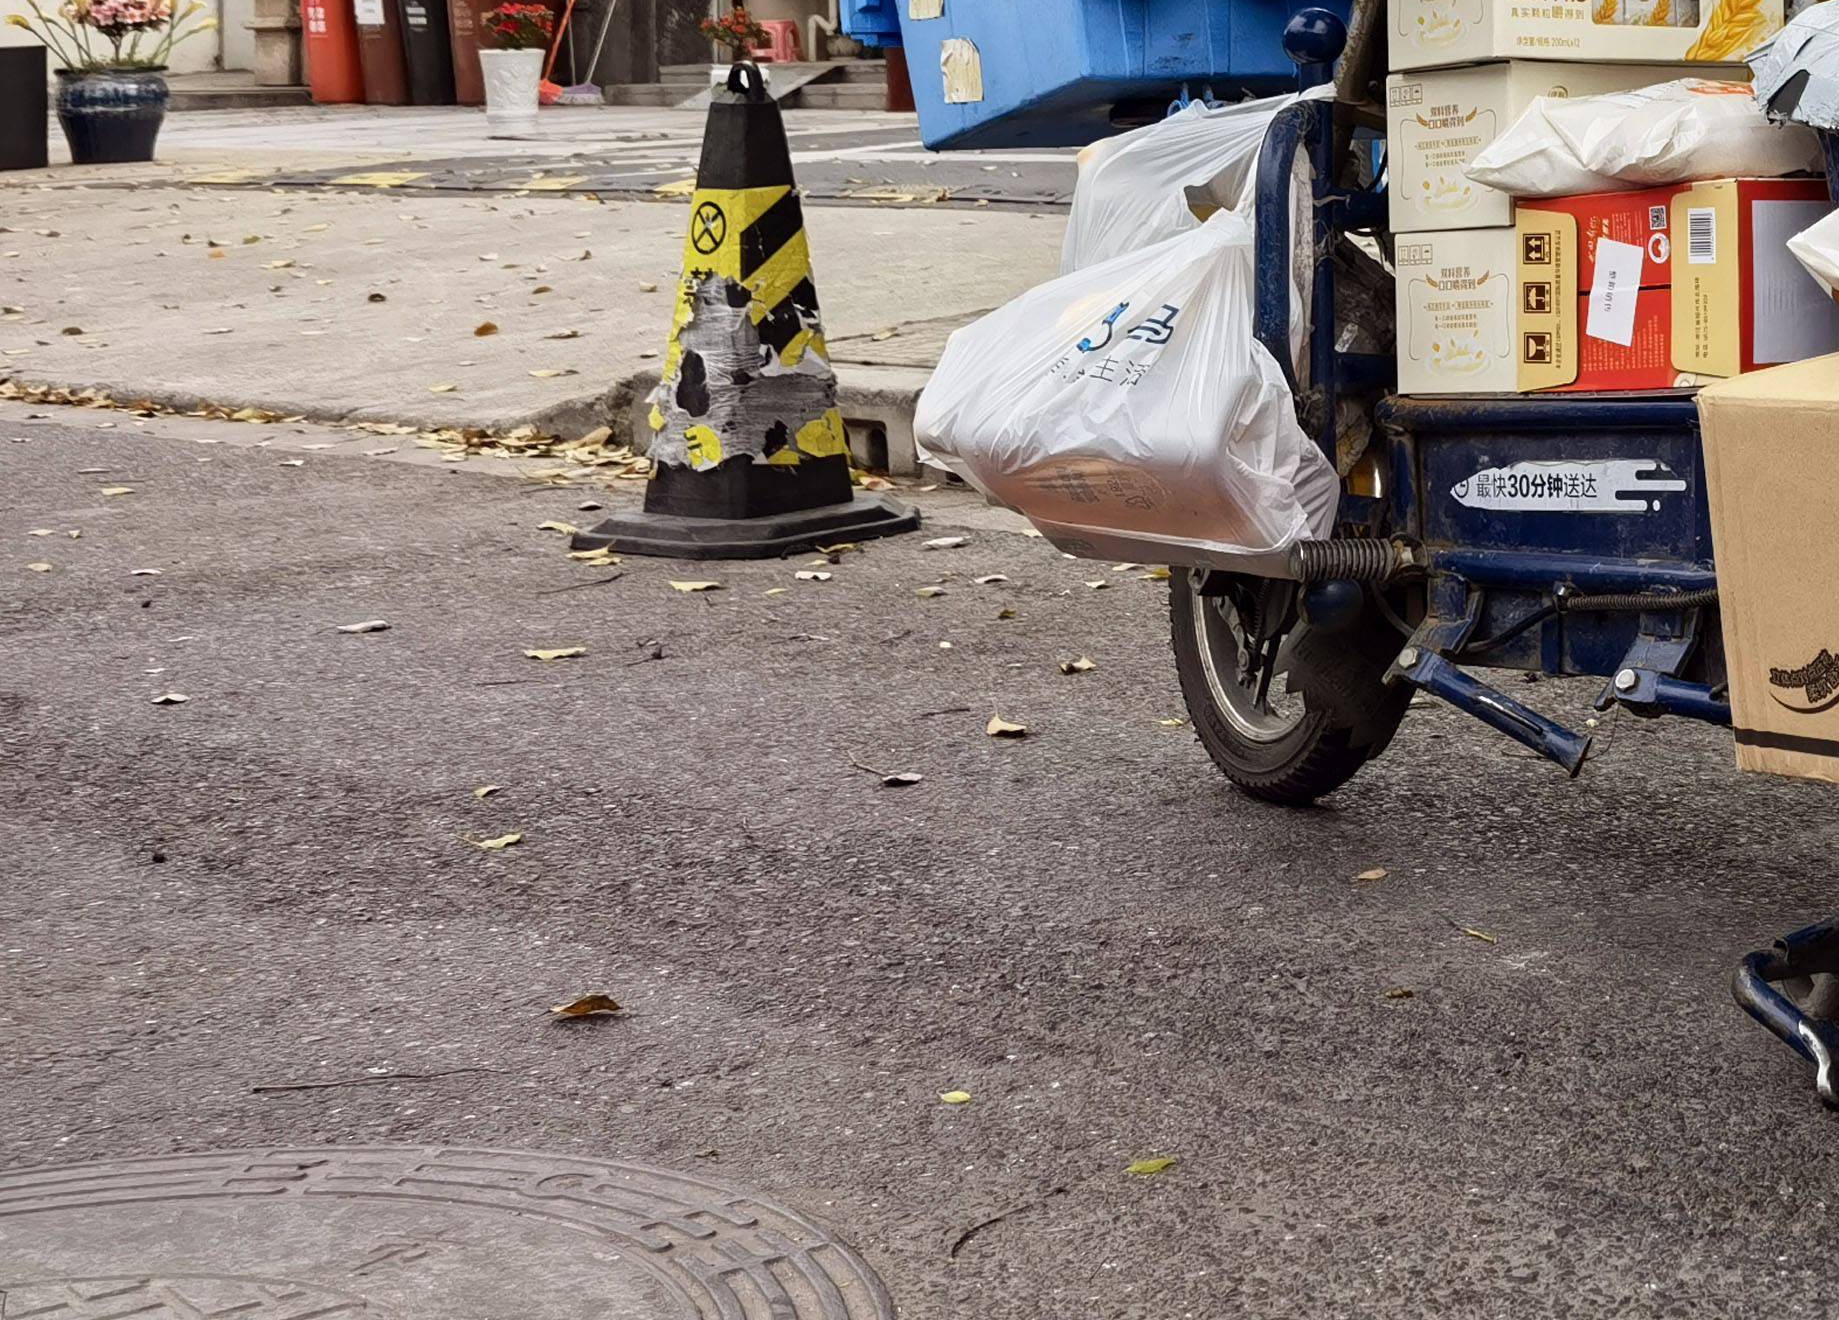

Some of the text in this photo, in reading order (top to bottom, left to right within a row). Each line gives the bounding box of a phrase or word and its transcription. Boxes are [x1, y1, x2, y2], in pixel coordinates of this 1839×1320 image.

[1476, 473, 1597, 499] 最快30分钟送达
